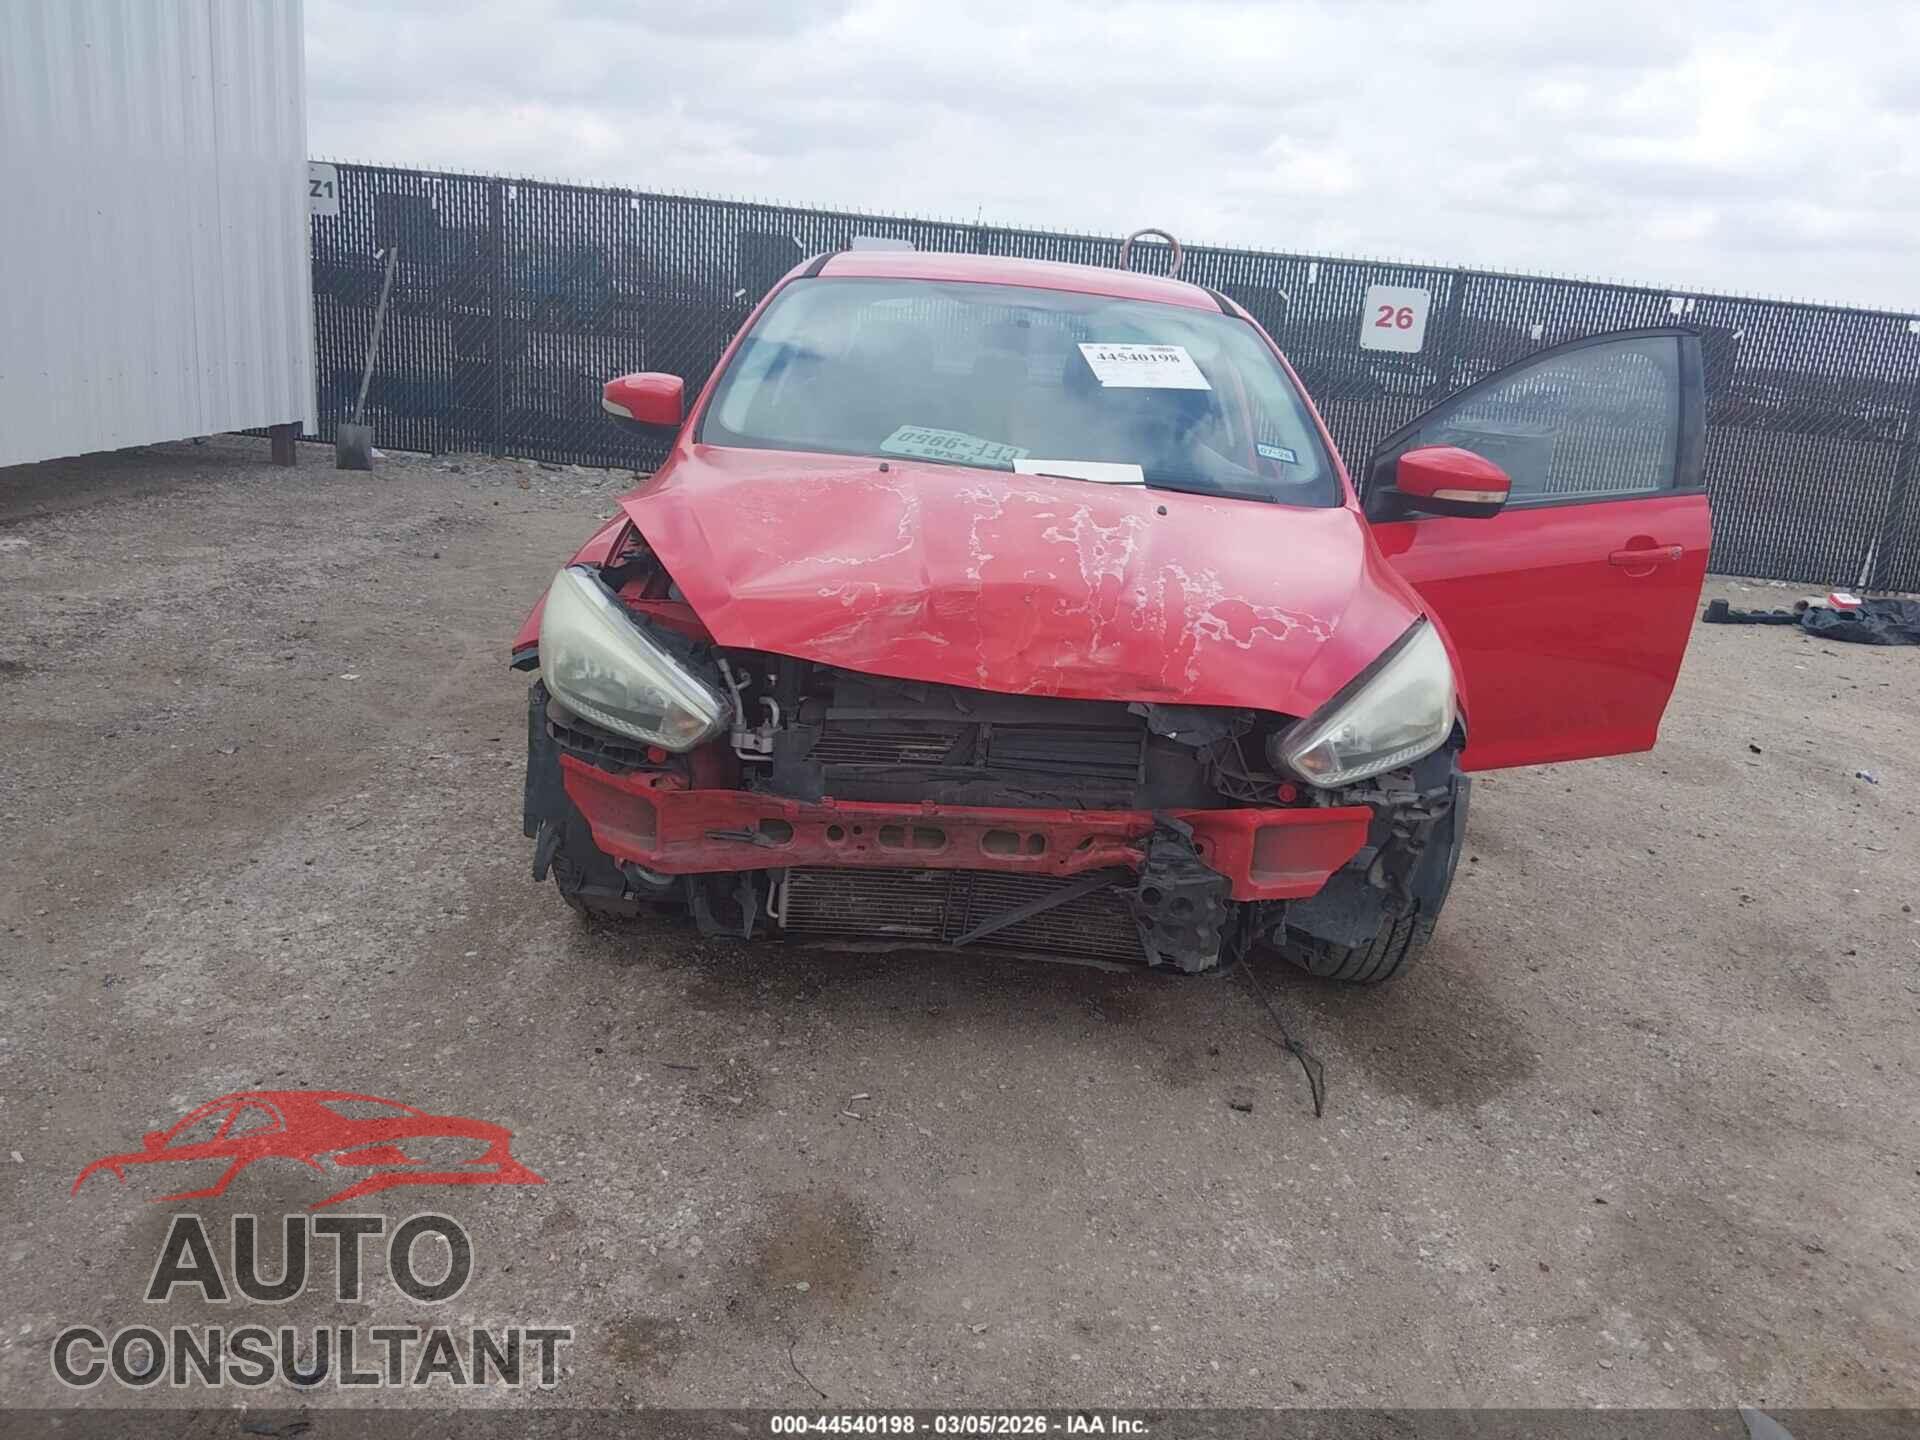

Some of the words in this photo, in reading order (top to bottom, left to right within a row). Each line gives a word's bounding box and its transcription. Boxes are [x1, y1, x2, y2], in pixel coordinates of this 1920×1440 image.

[308, 179, 334, 199] Z1
[1375, 305, 1414, 330] 26
[1097, 352, 1181, 364] 44540198
